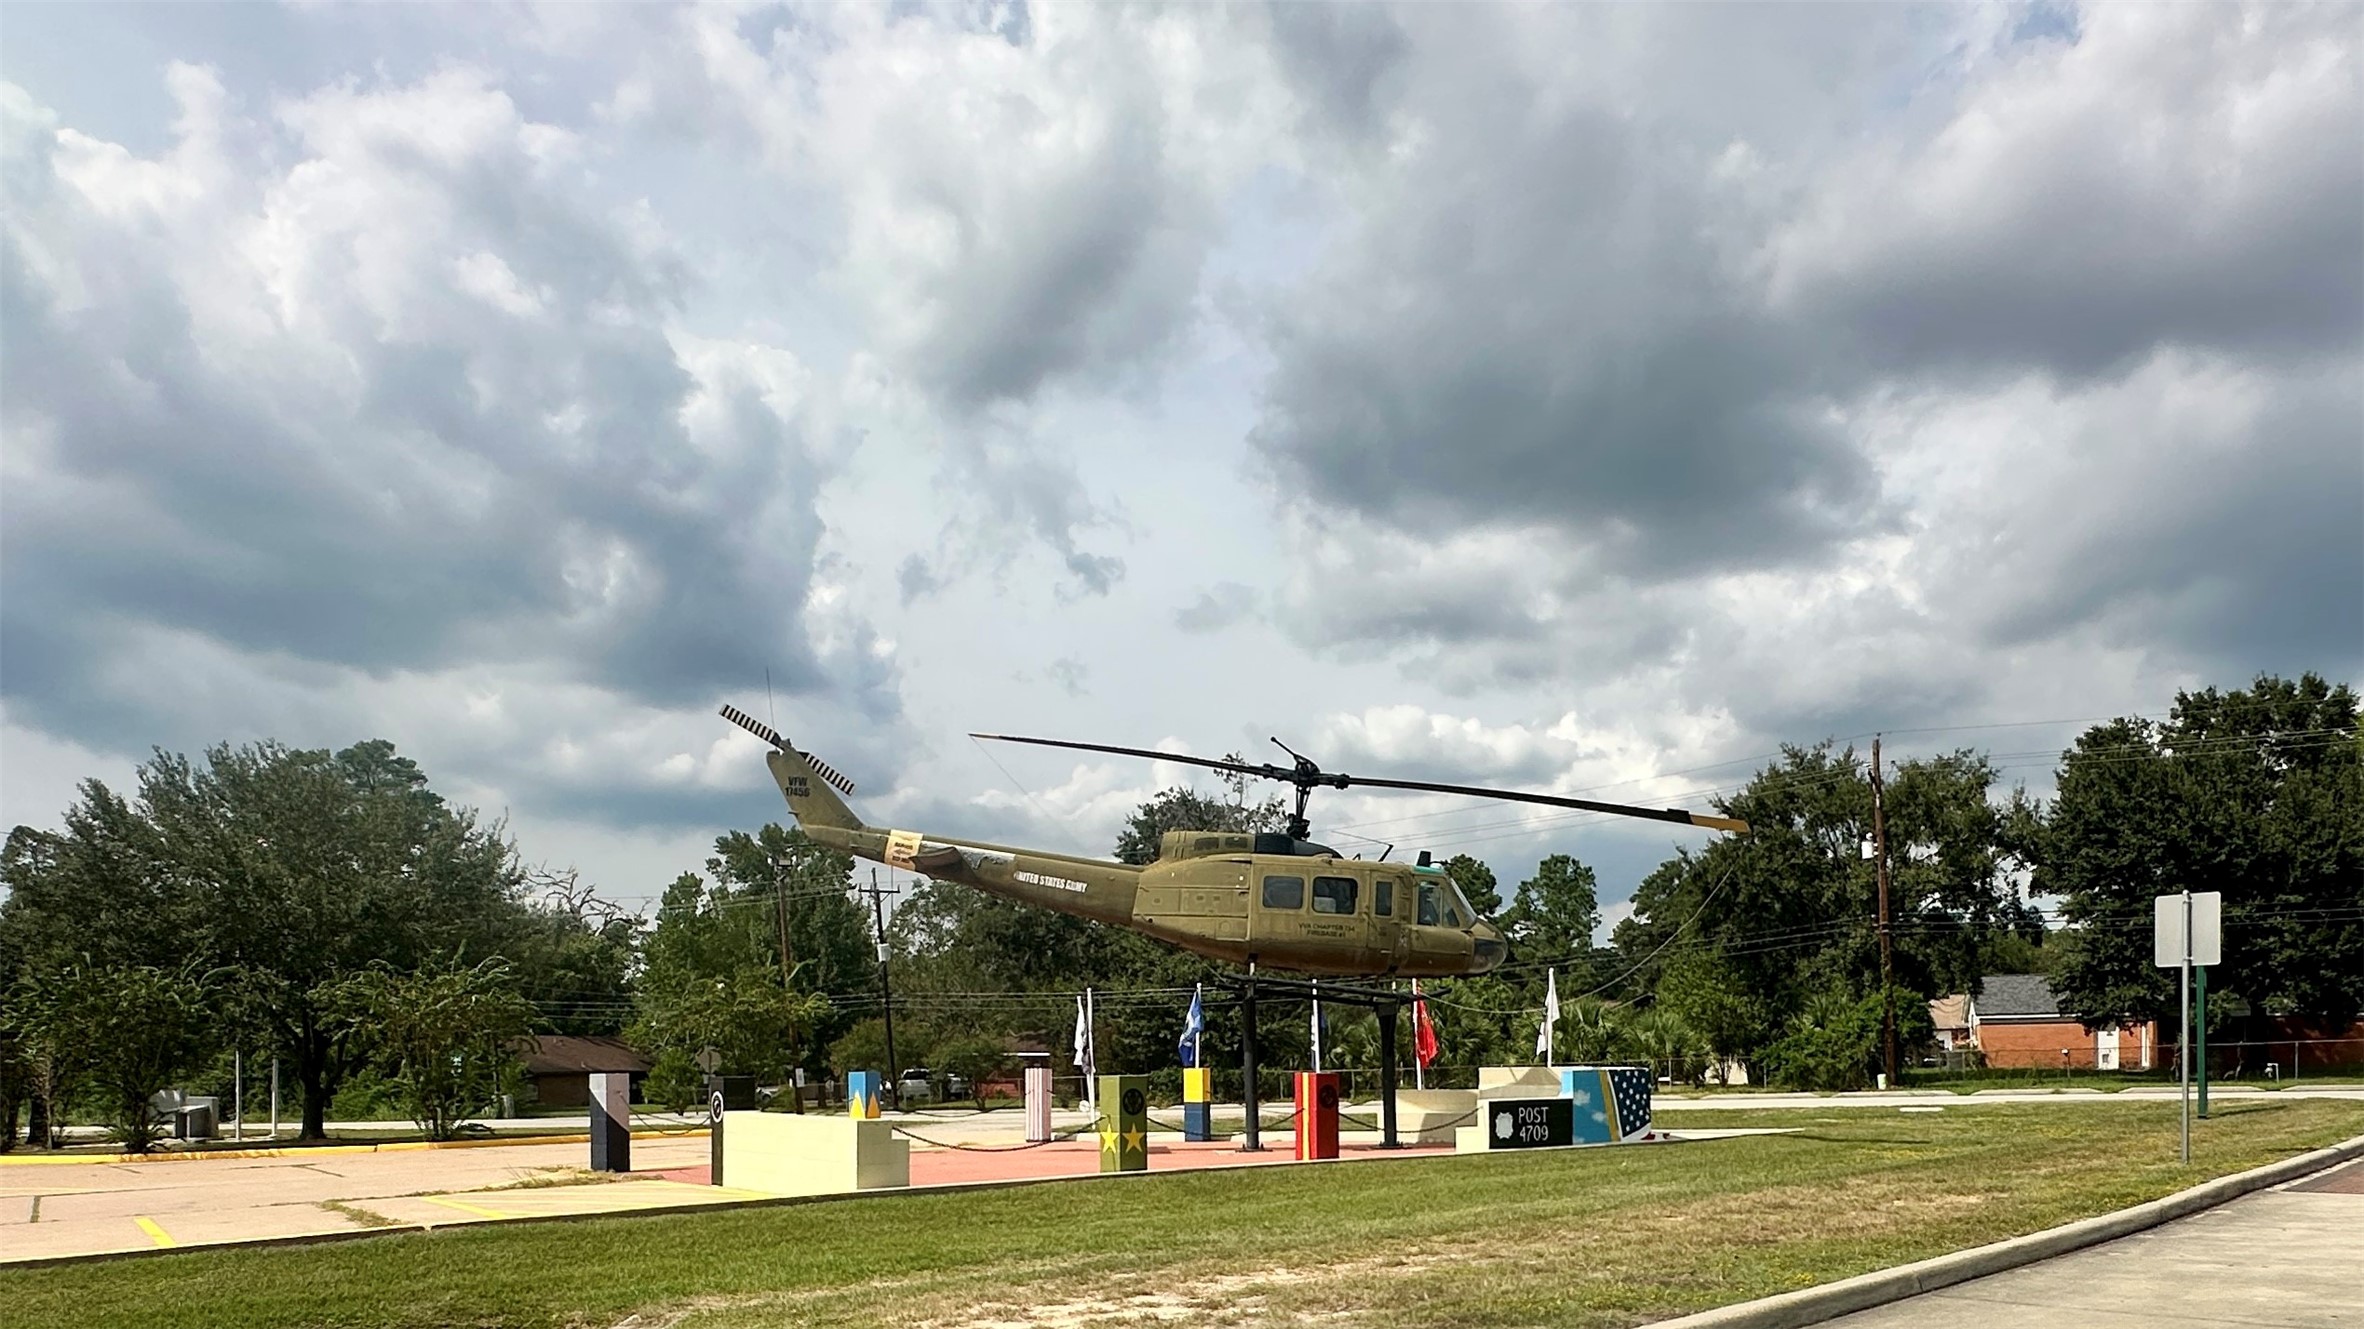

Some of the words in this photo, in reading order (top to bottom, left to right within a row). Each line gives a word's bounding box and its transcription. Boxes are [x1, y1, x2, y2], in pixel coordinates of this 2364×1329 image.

[788, 776, 808, 786] VFW
[1014, 870, 1039, 884] UNITED
[1039, 875, 1065, 889] STATES
[1313, 923, 1344, 931] CHAPTER
[1518, 1106, 1549, 1124] POST
[1519, 1125, 1549, 1142] 4709
